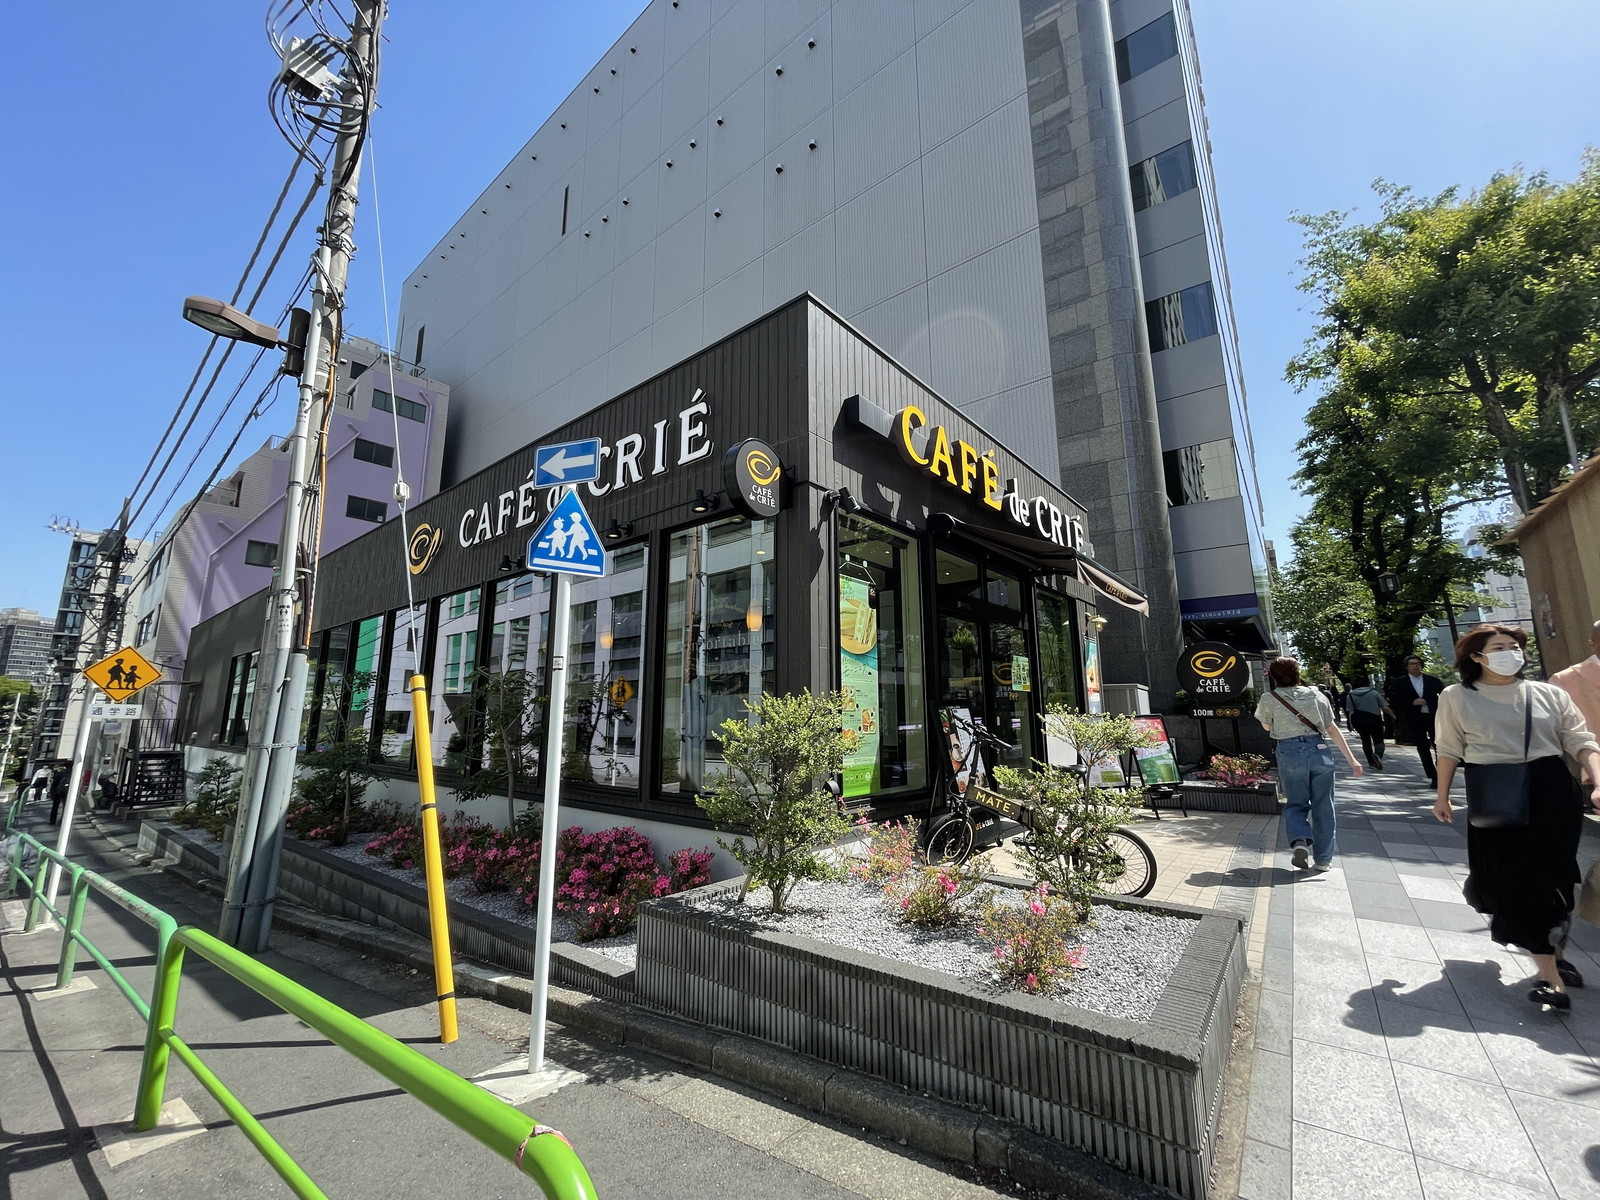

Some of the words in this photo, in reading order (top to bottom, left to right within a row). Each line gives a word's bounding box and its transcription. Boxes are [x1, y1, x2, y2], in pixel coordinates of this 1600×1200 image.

[459, 468, 536, 548] CAFÉ
[587, 388, 712, 497] CRIÉ
[901, 405, 1003, 511] CAFÉ
[1009, 477, 1030, 527] de
[1036, 495, 1086, 555] CRIÉ
[752, 484, 773, 499] CAFÉ
[756, 494, 776, 508] CRIÉ
[1199, 677, 1226, 686] CAFÉ
[1205, 684, 1231, 693] CRIÉ
[91, 706, 137, 716] 通学路
[975, 790, 1015, 815] MATE.
